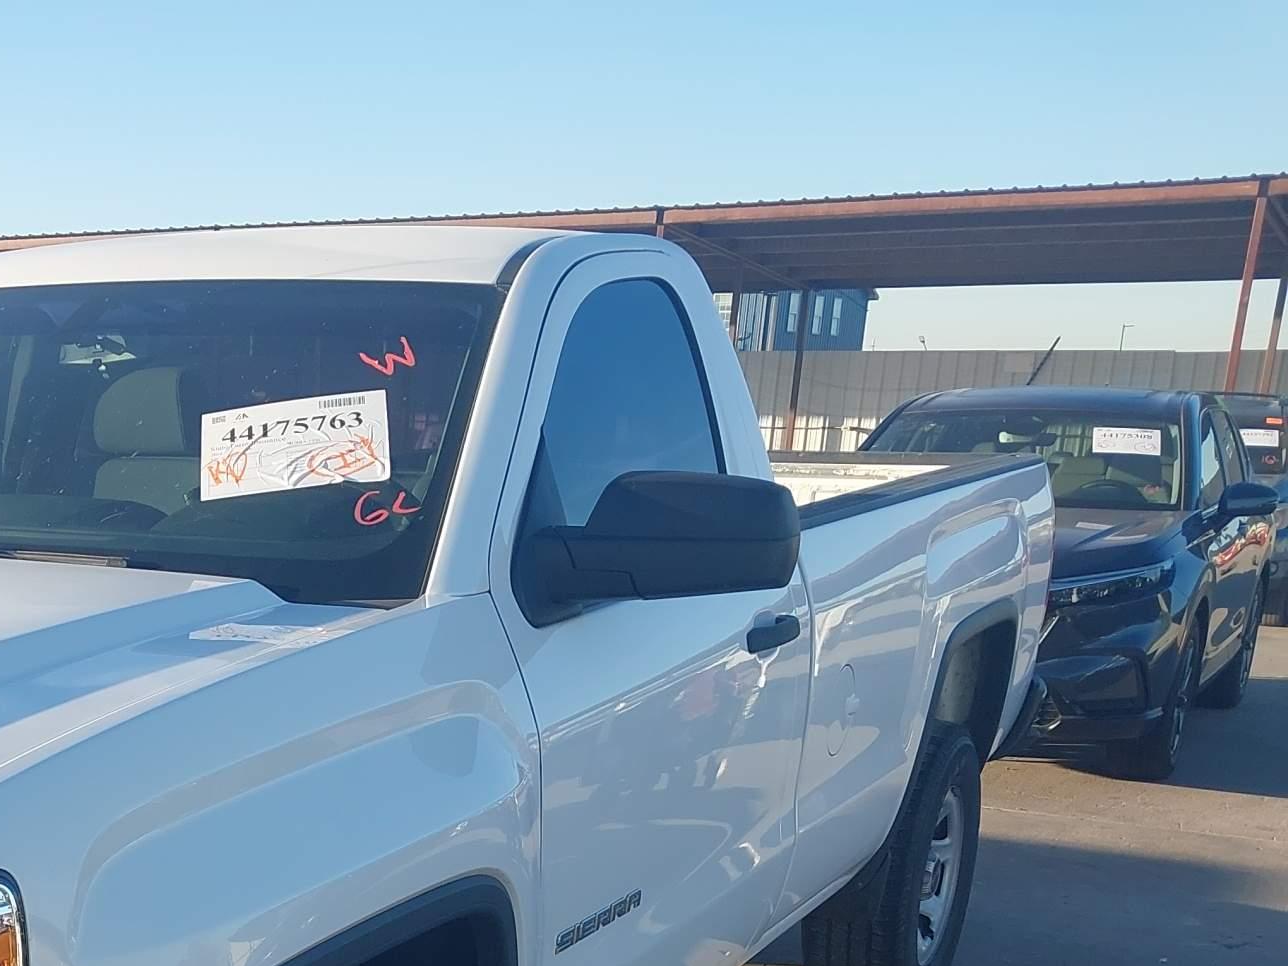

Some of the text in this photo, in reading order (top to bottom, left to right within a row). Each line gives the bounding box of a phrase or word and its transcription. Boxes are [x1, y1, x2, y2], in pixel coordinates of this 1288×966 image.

[359, 336, 416, 376] W
[221, 411, 364, 443] 44175763
[555, 888, 642, 956] SIERRA
